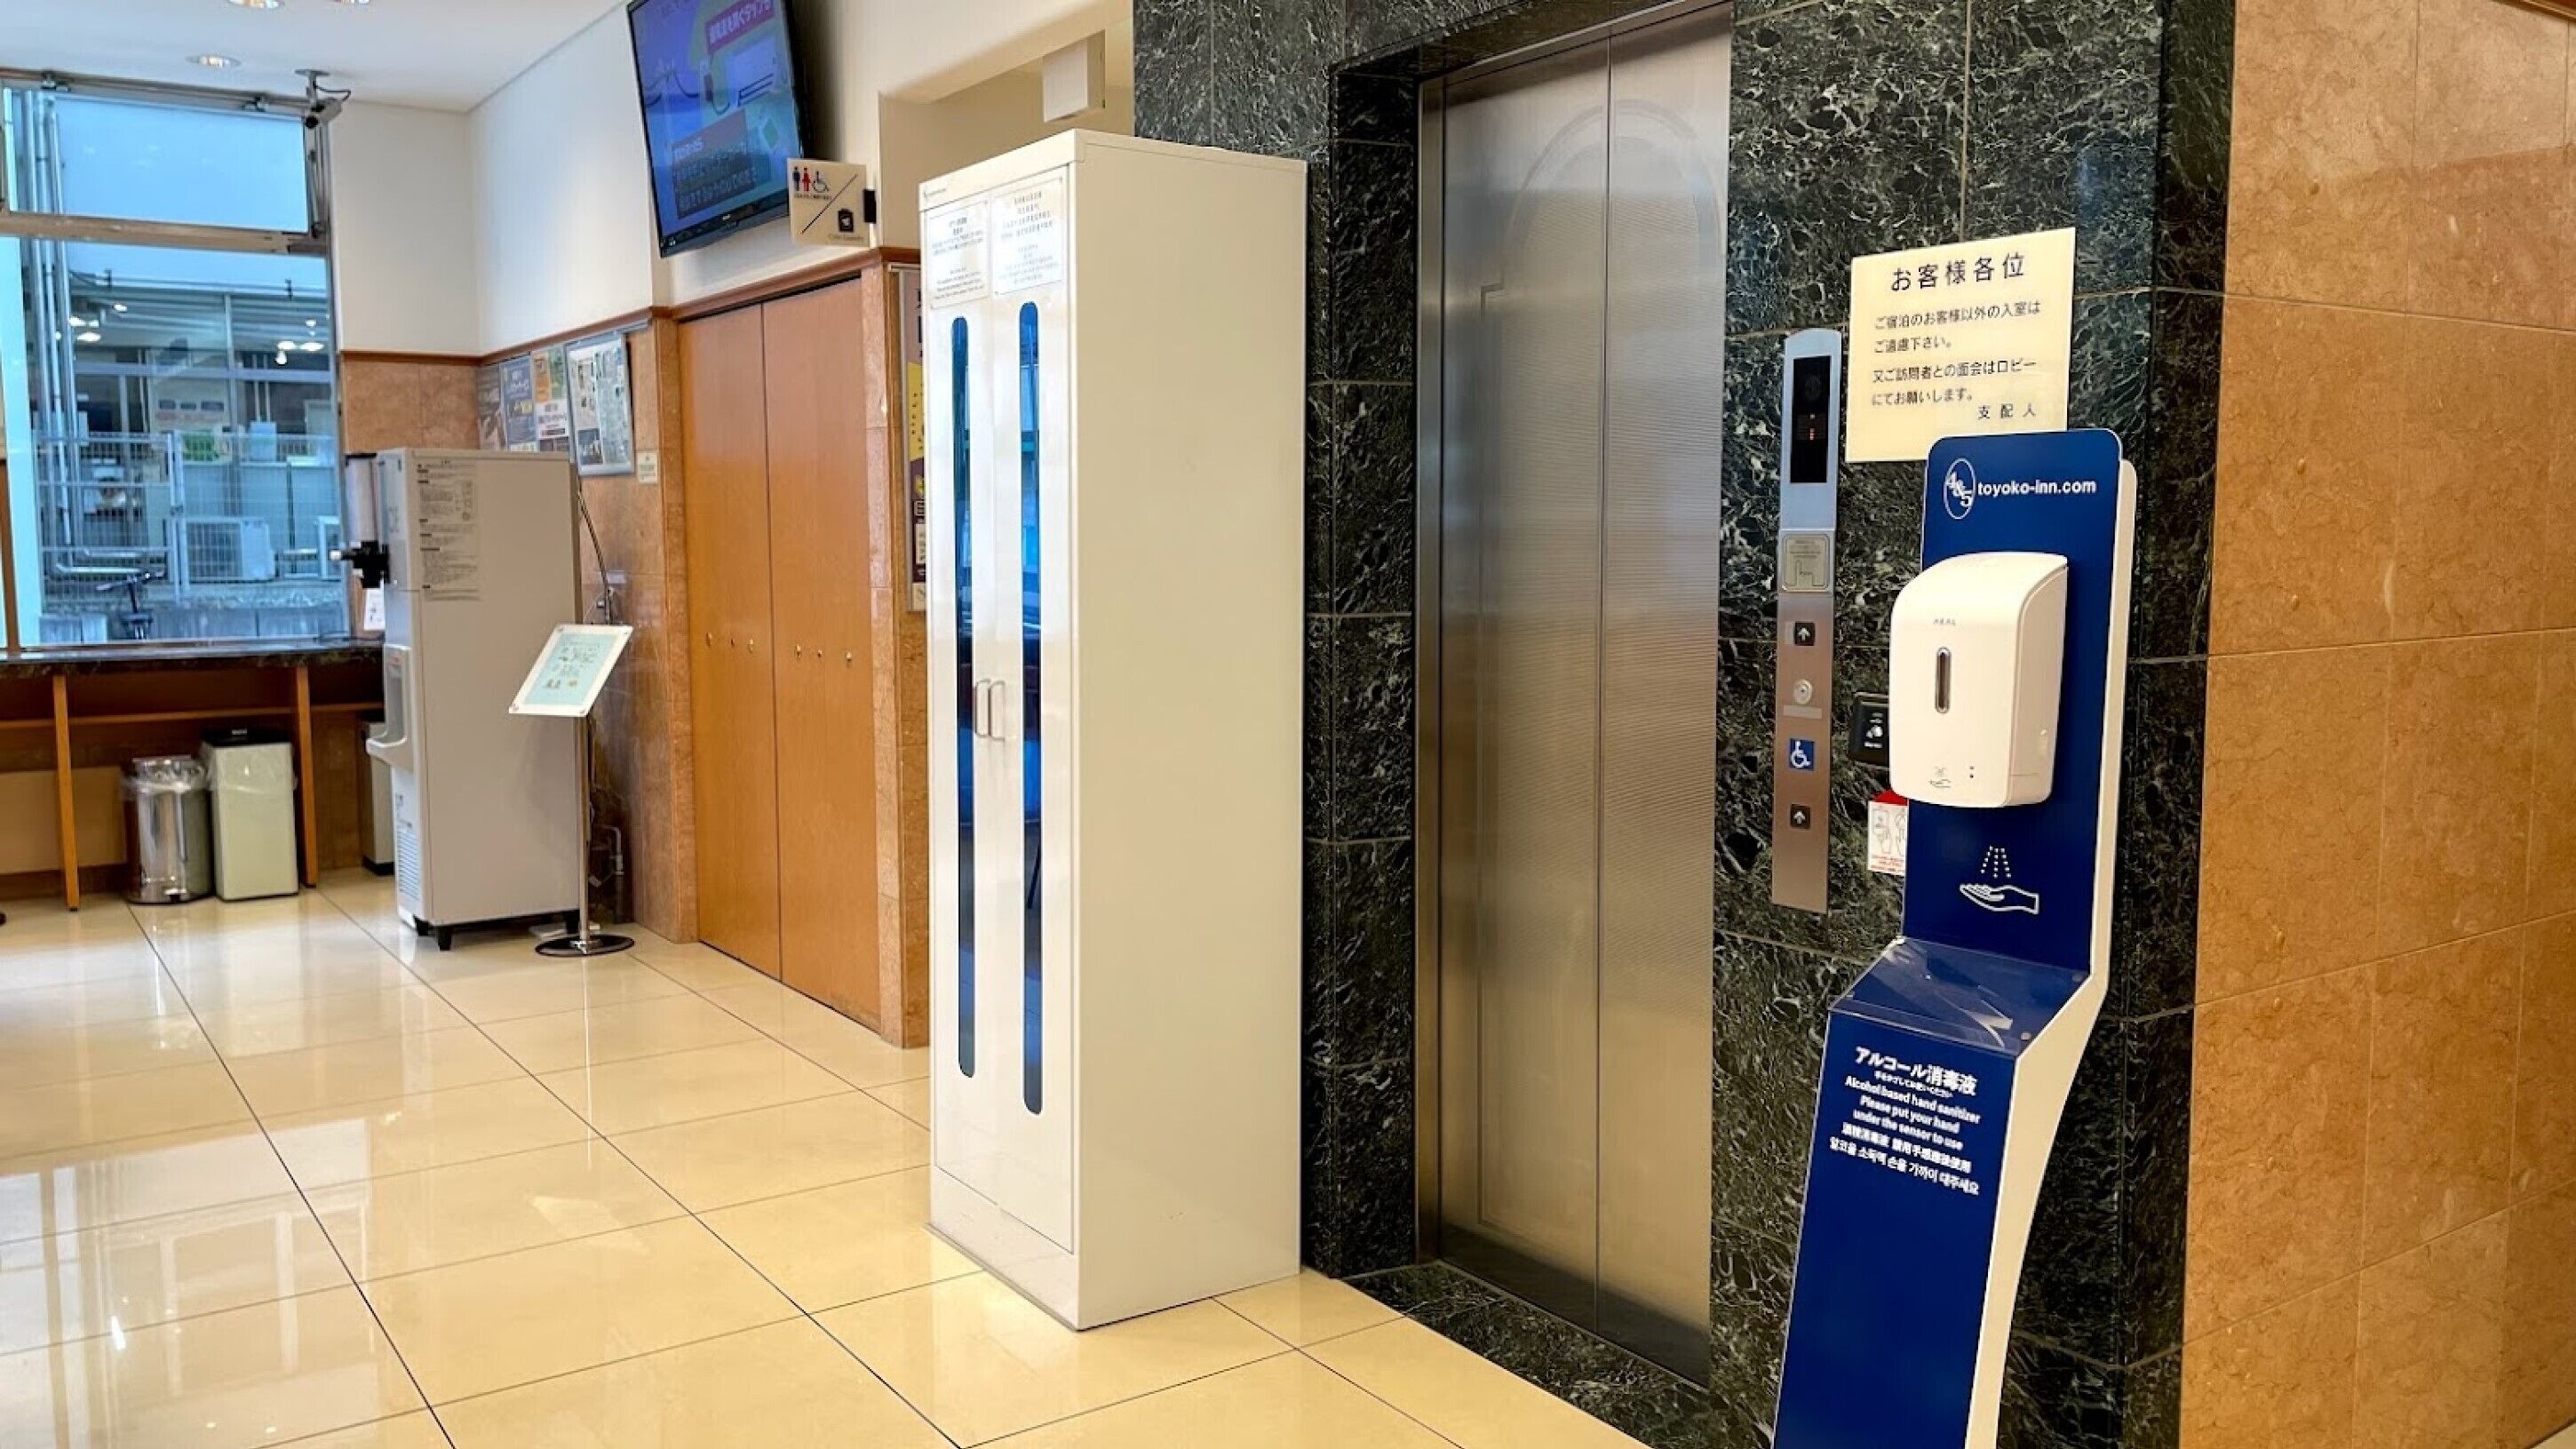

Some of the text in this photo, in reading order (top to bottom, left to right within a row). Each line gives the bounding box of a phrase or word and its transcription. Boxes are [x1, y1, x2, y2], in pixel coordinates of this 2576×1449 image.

[1890, 252, 2026, 291] お客様各位
[1874, 300, 2041, 330] ご宿泊のお客様以外の入室は
[1873, 335, 1952, 354] ご遠慮下さい。
[1872, 360, 2036, 383] 又ご訪問者との面会はロビー
[1872, 388, 1973, 407] にてお願いします。
[1977, 478, 2097, 498] toyoko-inn.com
[1856, 1047, 1976, 1095] アルコール消毒液
[1860, 1095, 1960, 1133] Please put your hand
[1912, 1093, 1936, 1111] hand
[1853, 1110, 1963, 1150] under the sensor to use
